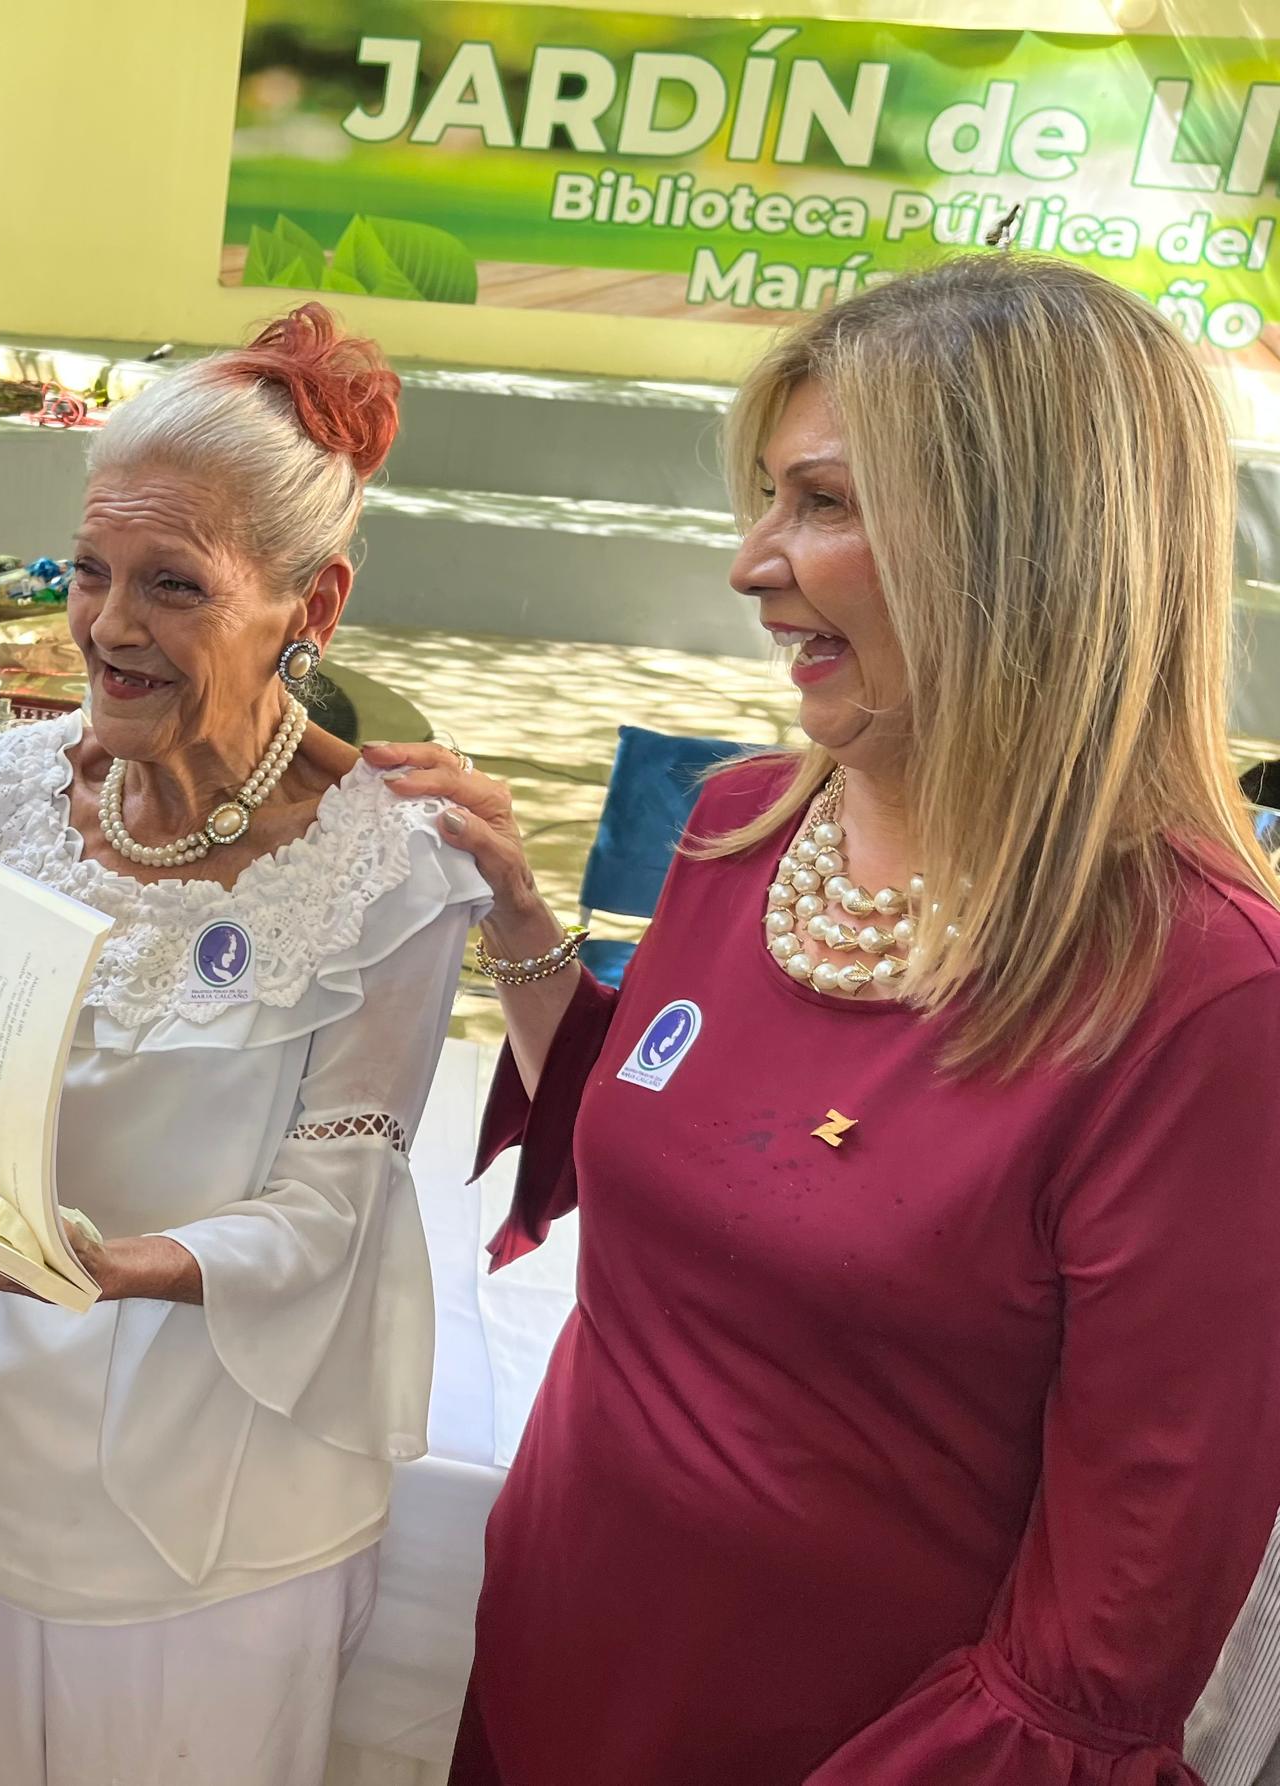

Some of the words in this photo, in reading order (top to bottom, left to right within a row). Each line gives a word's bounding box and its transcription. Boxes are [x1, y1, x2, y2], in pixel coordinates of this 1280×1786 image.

[341, 27, 891, 168] JARDÍN
[925, 80, 1090, 181] de
[550, 169, 869, 240] Biblioteca
[1157, 211, 1276, 272] del
